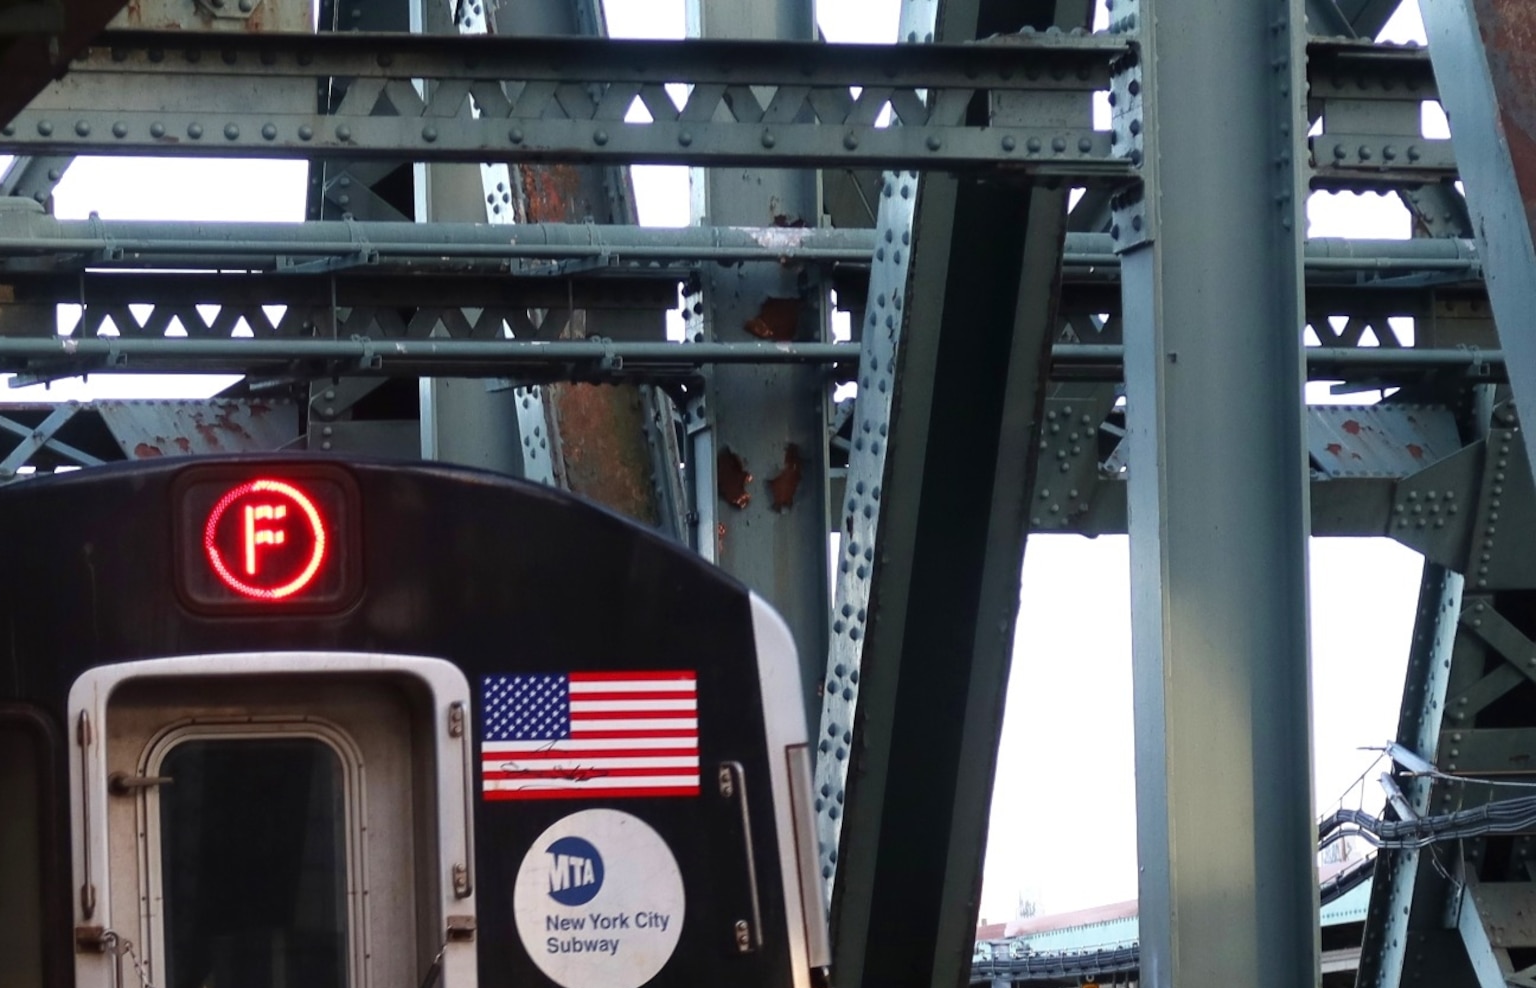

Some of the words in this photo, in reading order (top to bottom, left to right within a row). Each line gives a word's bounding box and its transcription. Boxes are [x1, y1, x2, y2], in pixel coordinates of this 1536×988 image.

[244, 504, 287, 575] F
[547, 852, 596, 893] MTA
[546, 914, 585, 932] New
[589, 913, 630, 930] York
[635, 911, 670, 931] City
[546, 936, 620, 956] Subway
